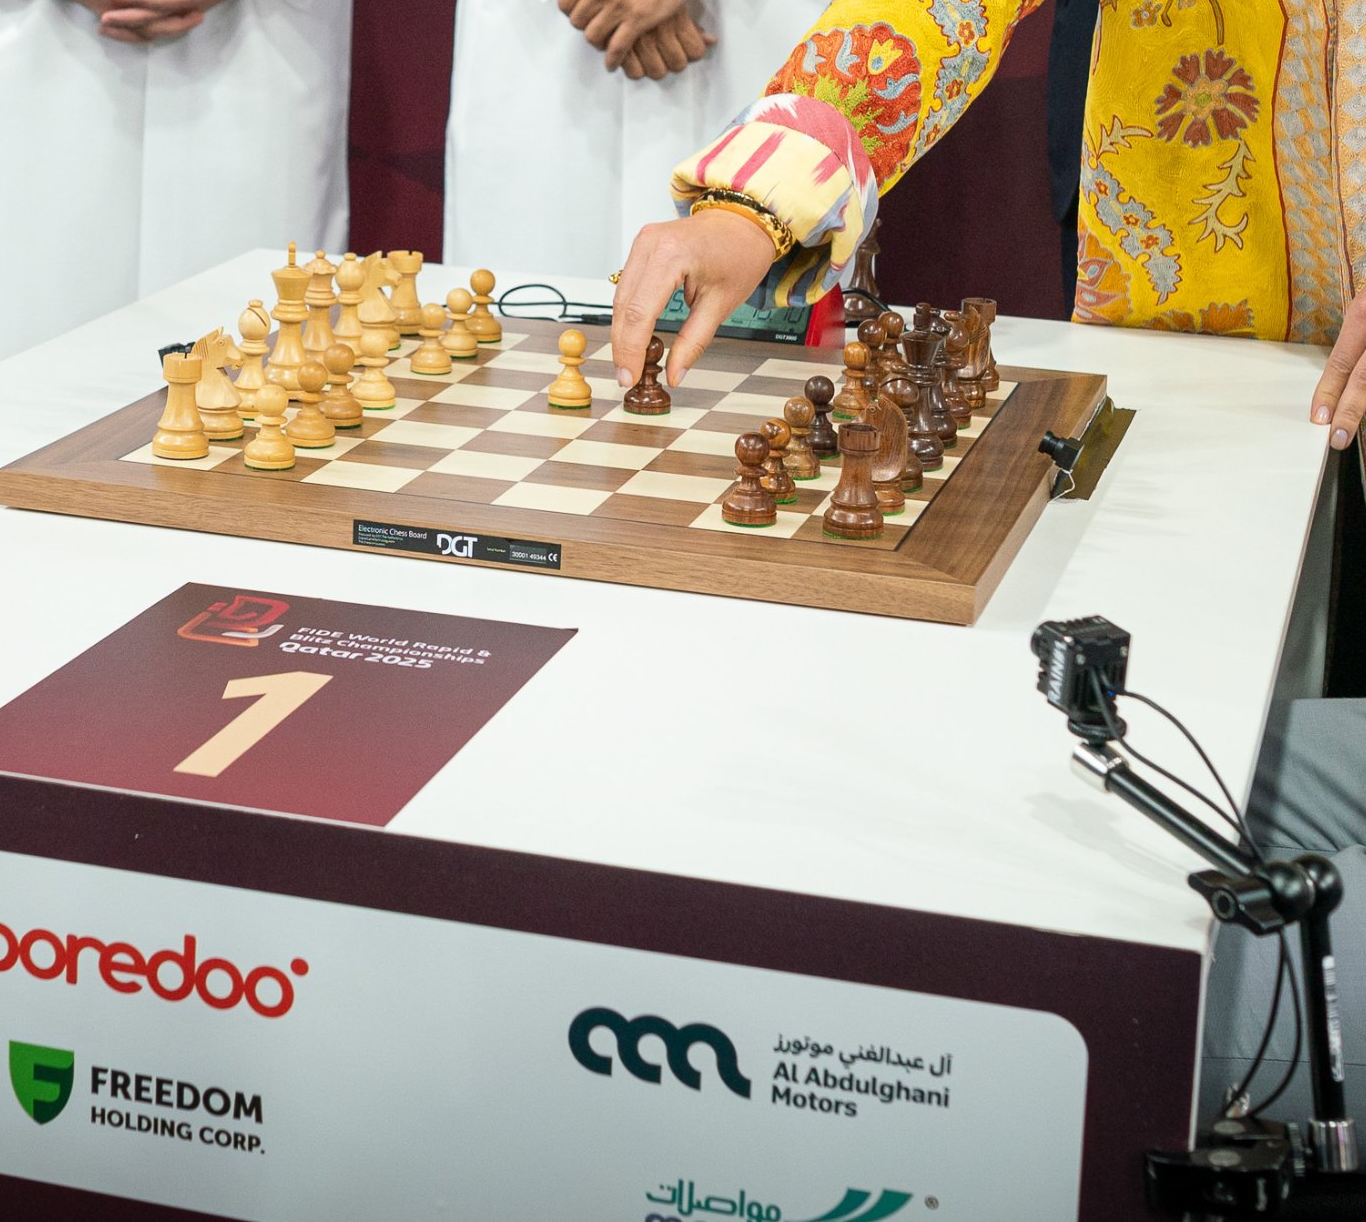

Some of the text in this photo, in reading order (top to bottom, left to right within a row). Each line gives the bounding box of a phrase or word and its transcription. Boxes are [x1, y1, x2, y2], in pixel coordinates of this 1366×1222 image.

[357, 524, 427, 540] Electronic Chess Board
[436, 533, 479, 558] DGT
[279, 641, 435, 670] Qatar 2025
[289, 633, 486, 665] Blitz Championships
[298, 627, 492, 658] FIDE World Rapid &
[173, 671, 334, 777] 1
[773, 1033, 953, 1078] آل عبدالغني موتورز
[90, 1065, 264, 1125] FREEDOM
[770, 1084, 858, 1118] Motors
[773, 1061, 950, 1109] Al Abdulghani
[90, 1105, 267, 1156] HOLDING CORP.
